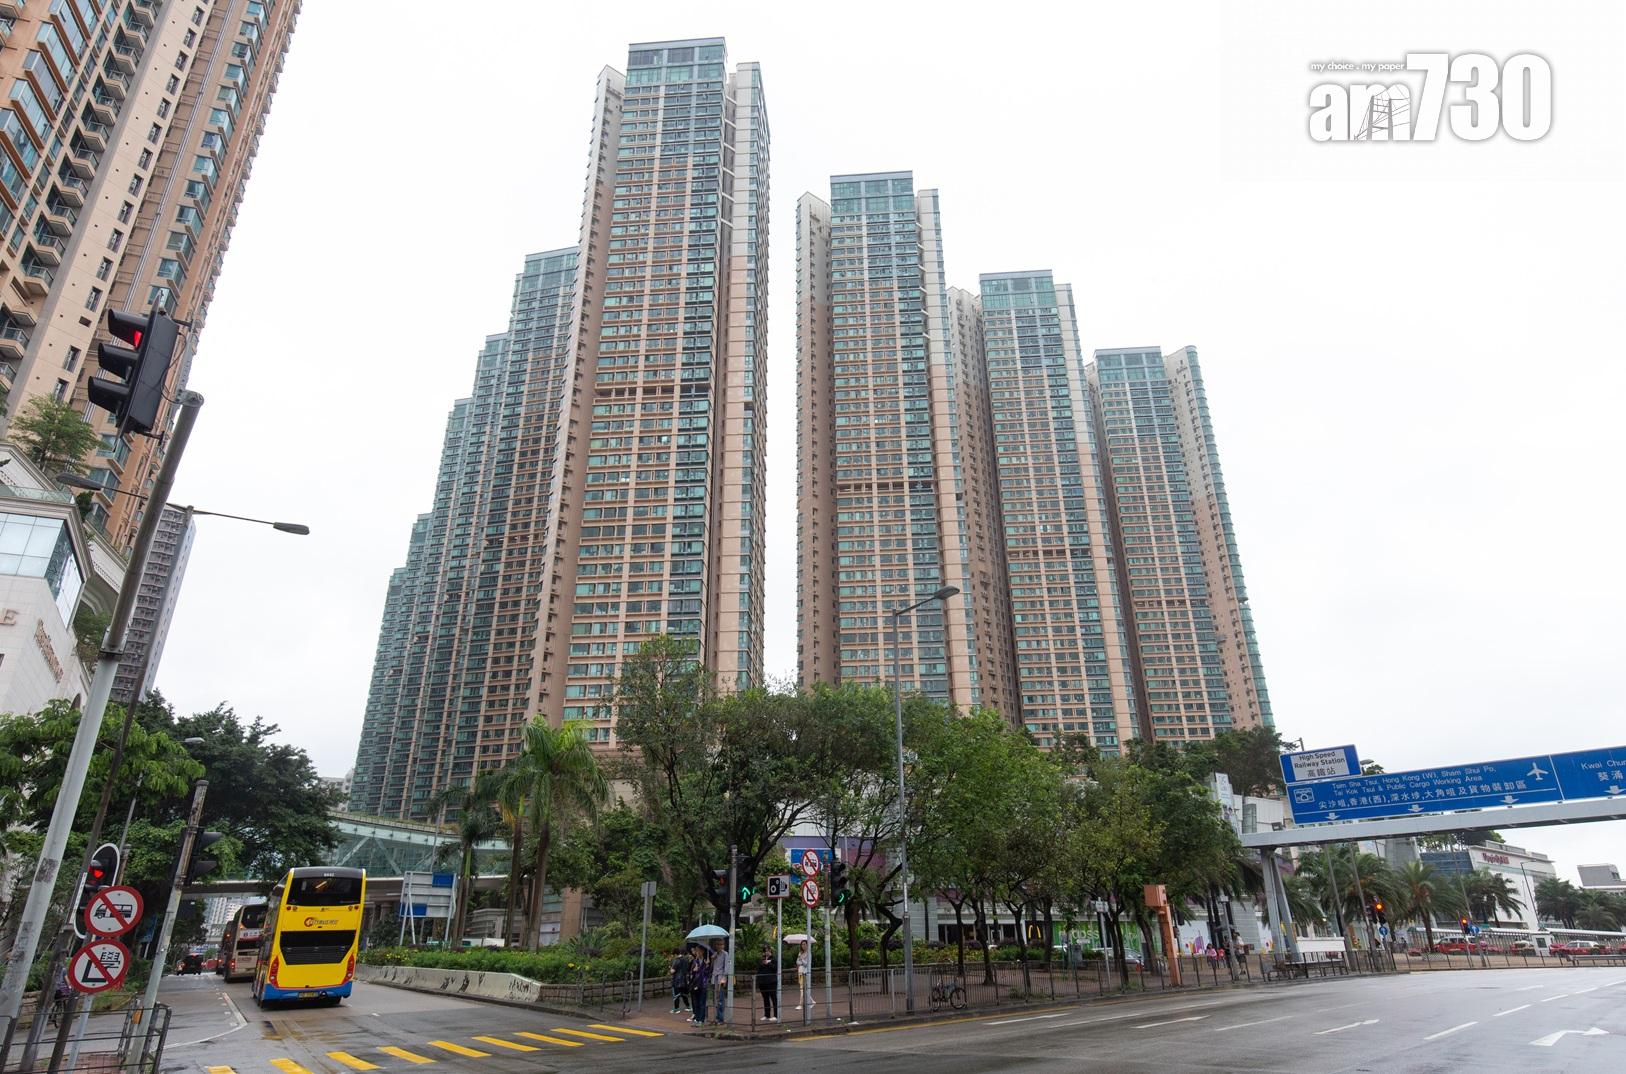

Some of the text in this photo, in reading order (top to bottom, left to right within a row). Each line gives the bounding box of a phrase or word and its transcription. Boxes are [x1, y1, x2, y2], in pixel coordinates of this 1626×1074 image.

[1299, 751, 1336, 761] High Speed
[1294, 757, 1345, 769] Railway Station
[1580, 761, 1603, 770] Kwai
[1383, 777, 1399, 785] Hong
[1402, 774, 1419, 782] Kong
[1441, 769, 1462, 777] Sham
[1464, 767, 1480, 775] Shui
[1386, 783, 1406, 791] Public
[1409, 780, 1430, 789] Cargo
[1433, 777, 1461, 786] Working
[1465, 774, 1483, 782] Area
